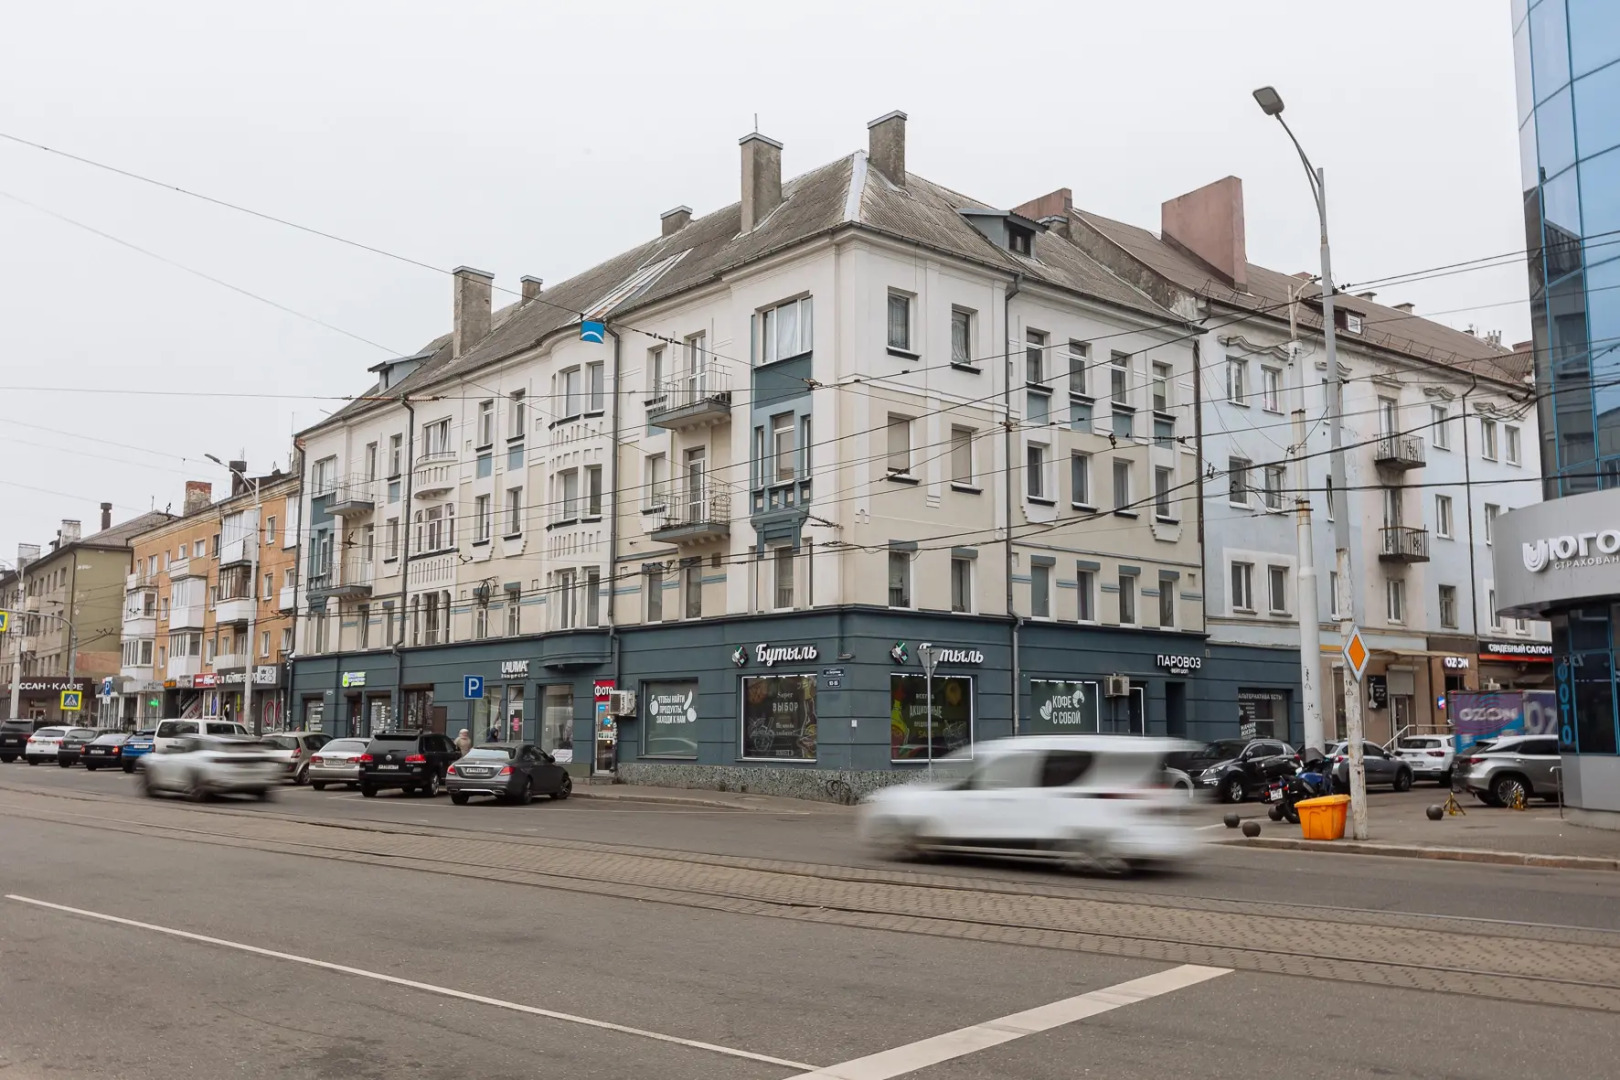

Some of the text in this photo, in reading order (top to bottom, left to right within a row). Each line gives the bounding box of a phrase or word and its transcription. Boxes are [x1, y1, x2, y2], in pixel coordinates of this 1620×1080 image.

[755, 643, 817, 666] Бутыль
[1488, 643, 1552, 654] СВАДЕБНЫЙ САЛОН
[501, 660, 529, 673] LAUMA
[1157, 654, 1201, 669] ПАРОВОЗ
[772, 702, 799, 713] ВЫБОР
[1052, 695, 1072, 708] КОФЕ
[1052, 710, 1081, 724] С СОБОЙ
[1459, 707, 1519, 721] OZON
